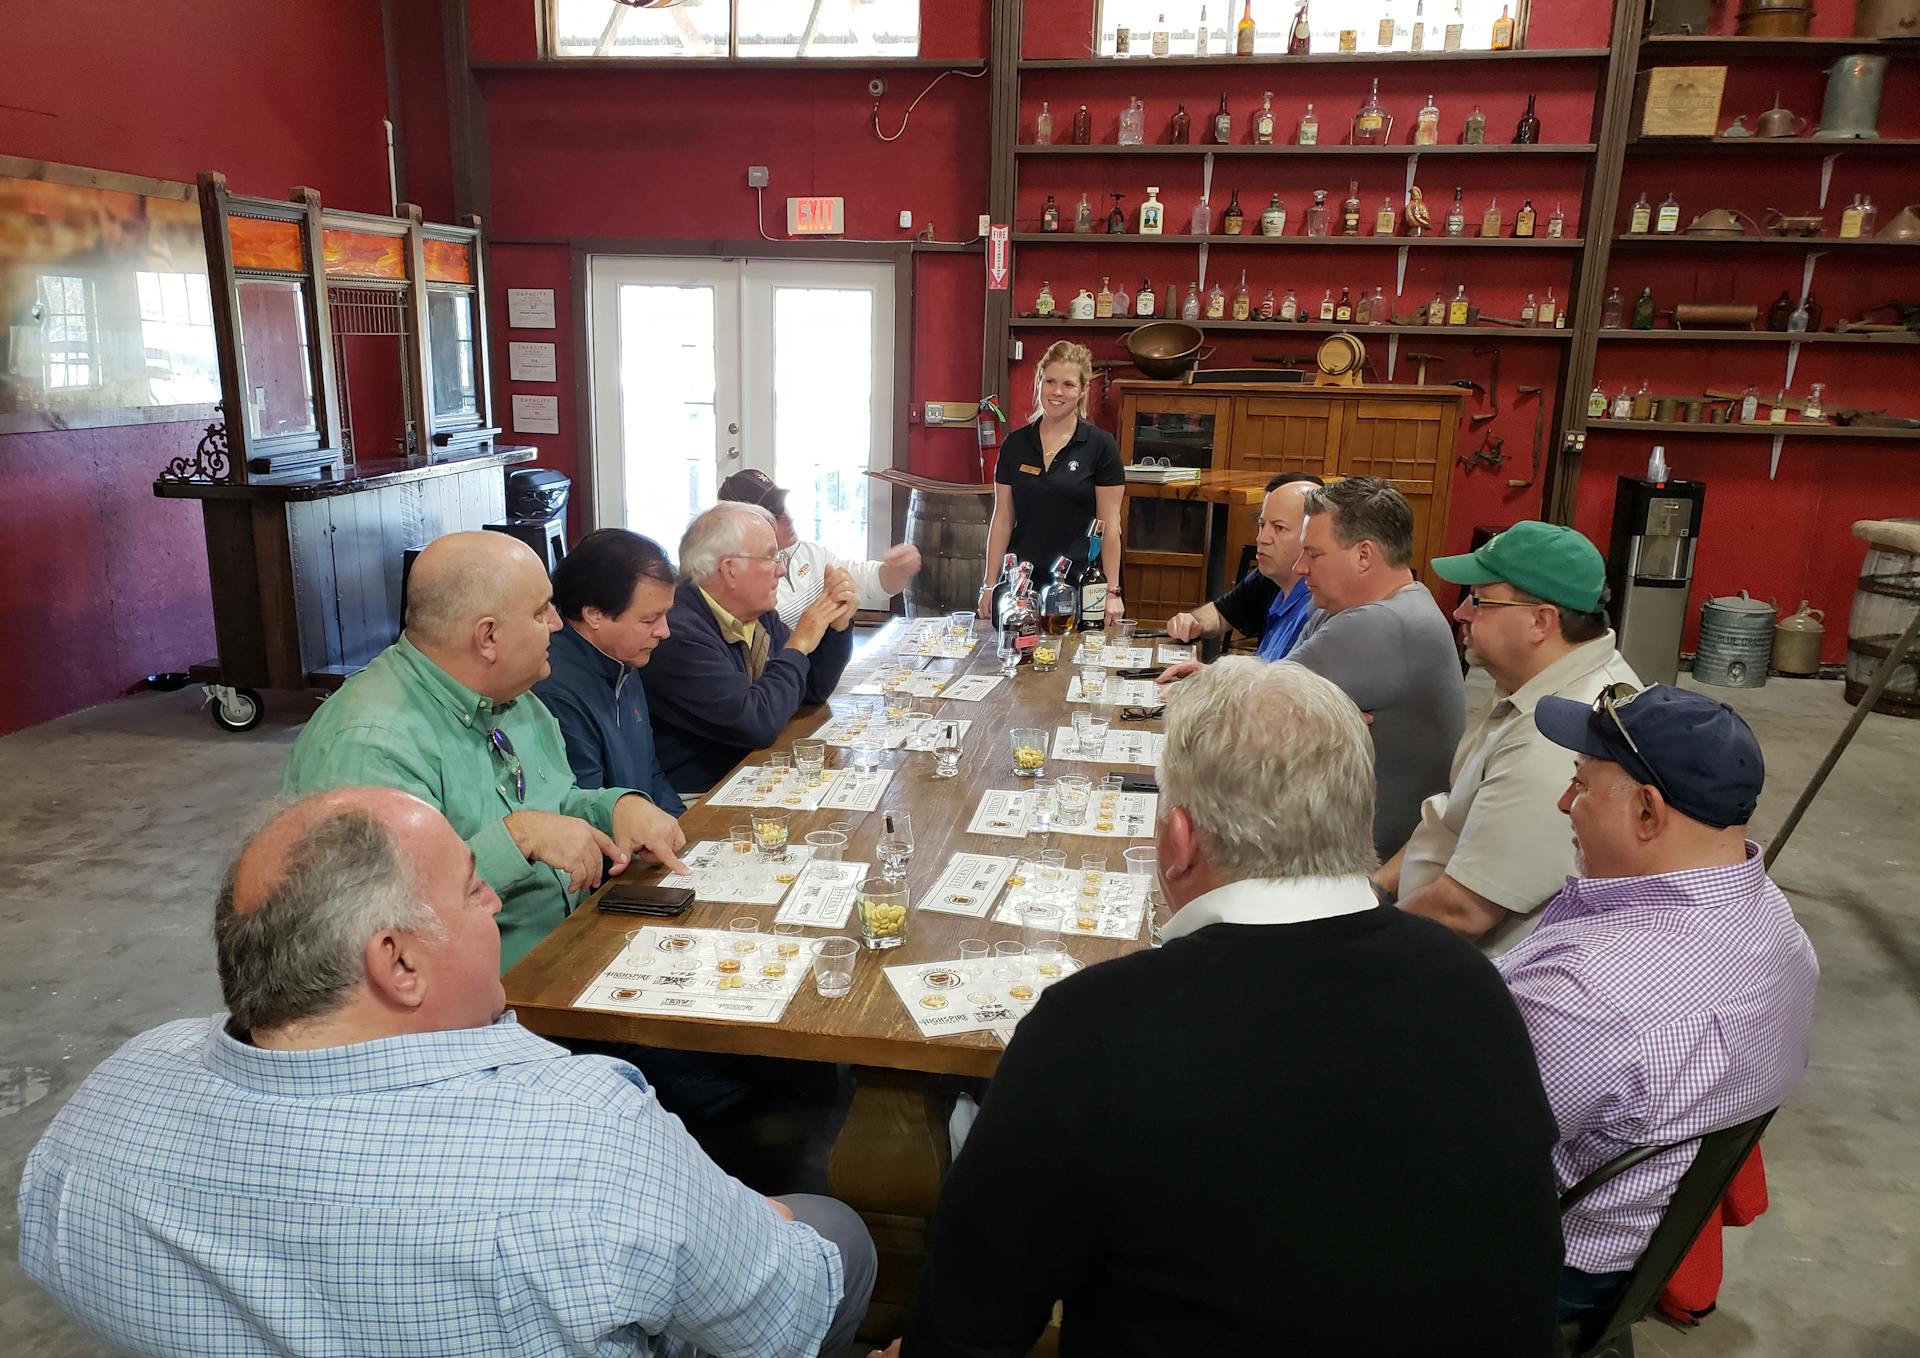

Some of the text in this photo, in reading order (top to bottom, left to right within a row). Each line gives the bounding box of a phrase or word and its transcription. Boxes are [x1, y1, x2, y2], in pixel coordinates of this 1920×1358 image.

[797, 199, 833, 230] EXIT
[993, 230, 1006, 239] FIRE
[1717, 634, 1766, 648] BLUE GRASS
[605, 971, 652, 980] HIGHSPIRE
[920, 1013, 968, 1025] HIGHSPIRE
